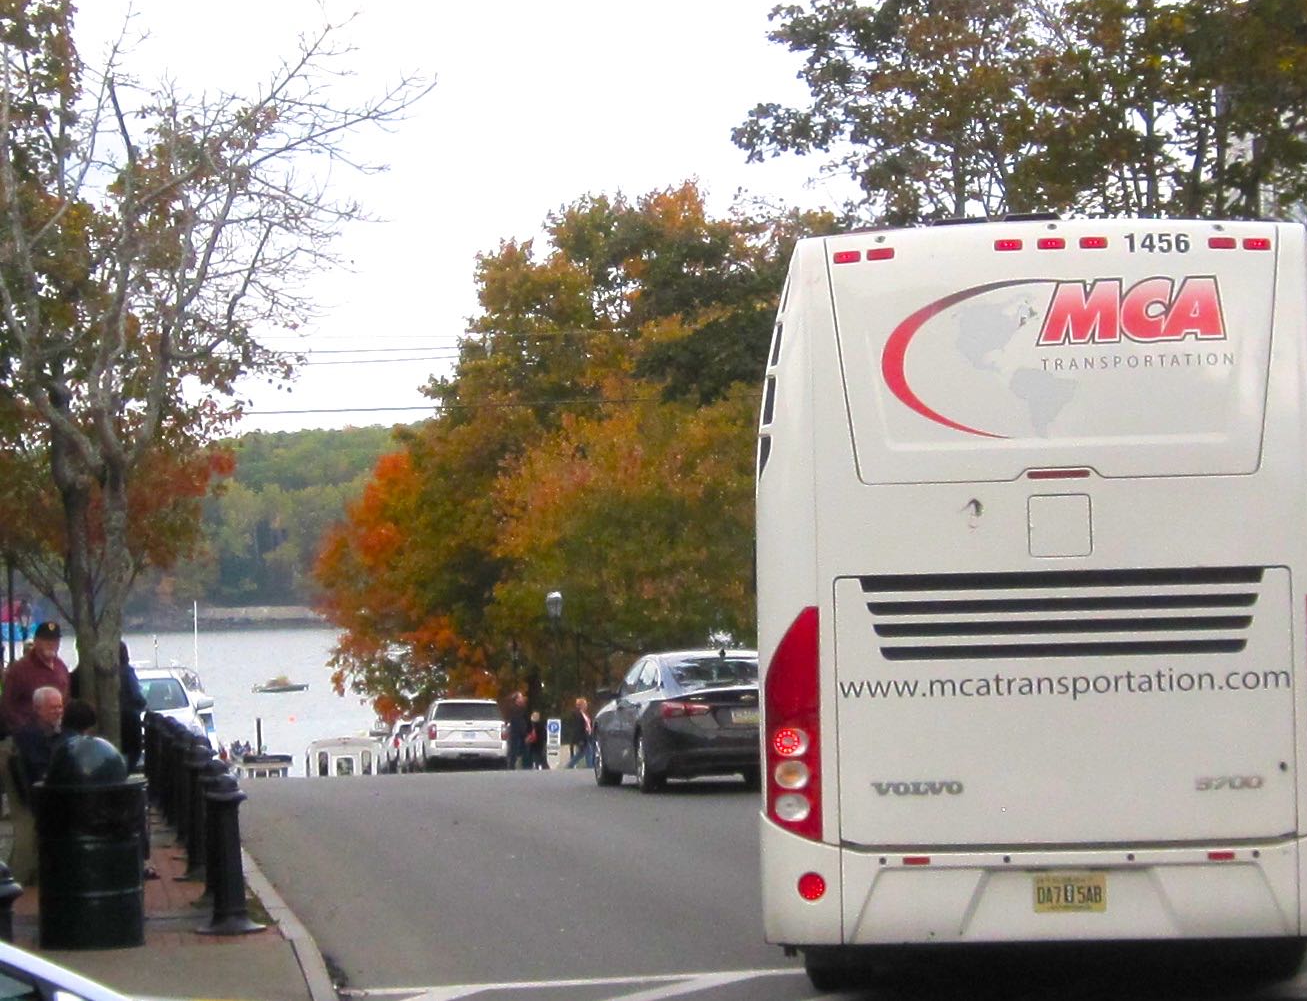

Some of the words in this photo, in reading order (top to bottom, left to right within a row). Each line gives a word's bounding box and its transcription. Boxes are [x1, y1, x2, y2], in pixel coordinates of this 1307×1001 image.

[1123, 232, 1191, 254] 1456
[1036, 272, 1227, 346] MCA
[1041, 352, 1235, 371] TRANSPORTATION
[838, 666, 1292, 700] www.mcatransportation.com
[869, 780, 964, 796] VOLVO
